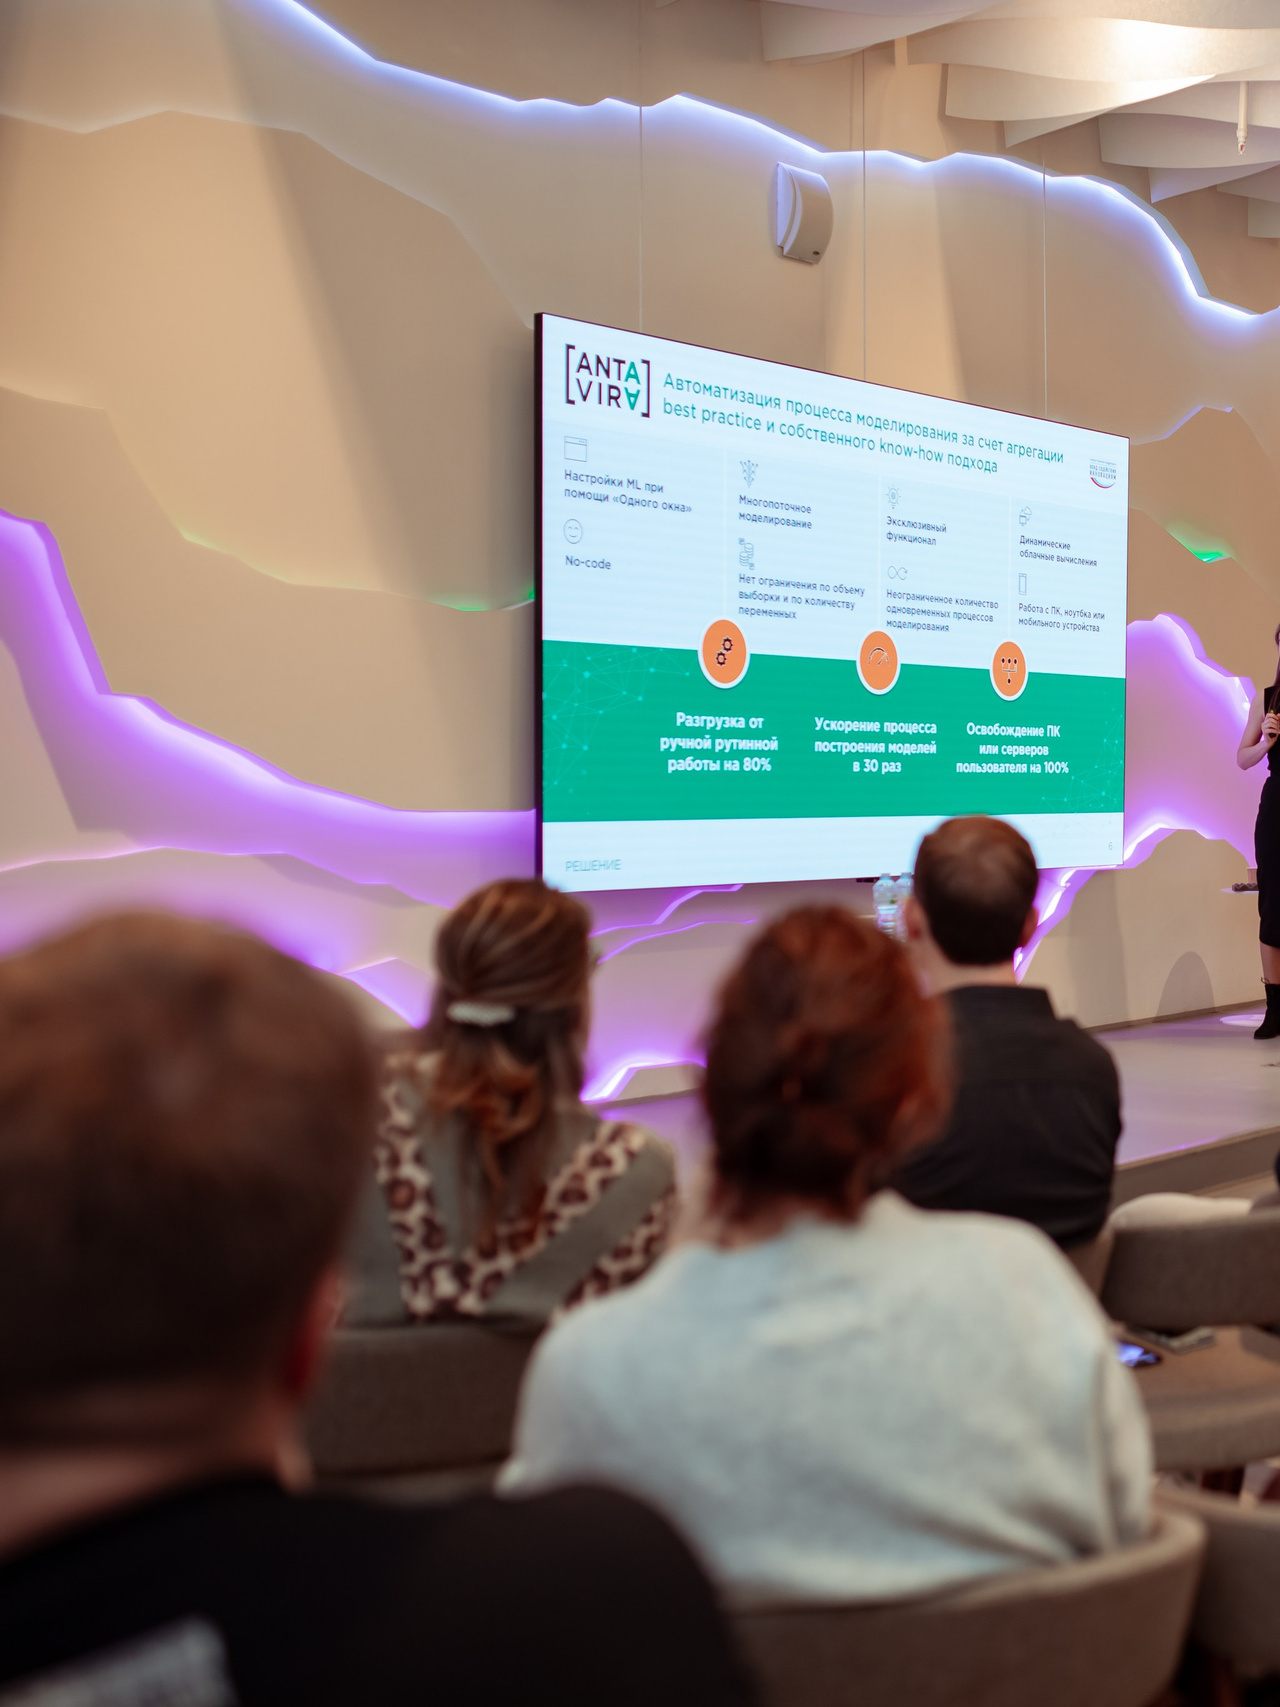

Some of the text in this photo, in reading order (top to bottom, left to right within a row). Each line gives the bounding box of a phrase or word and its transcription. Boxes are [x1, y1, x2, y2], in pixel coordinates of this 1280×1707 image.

[576, 352, 641, 385] ANTA
[663, 373, 1064, 465] Автоматизация процесса моделирования за счет агрегации
[663, 398, 998, 474] best practice и собственного know-how подхода
[564, 470, 664, 496] Настройки ML при
[564, 488, 692, 514] помощи «Одного окна»
[739, 495, 812, 514] Многопоточное
[739, 512, 812, 530] моделирование
[886, 516, 947, 533] Эксклюзивный
[886, 531, 937, 546] функционал
[1020, 535, 1071, 551] Динамические
[565, 555, 611, 570] No-code
[1020, 549, 1098, 567] облачные вычисления
[739, 573, 865, 597] Нет ограничения по объему
[739, 589, 855, 612] выборки и по количеству
[886, 589, 999, 610] Неограниченное количество
[739, 605, 797, 620] переменных
[886, 605, 994, 623] одновременных процессов
[1018, 603, 1105, 621] Работа с ПК, ноутбука или
[886, 619, 950, 633] моделирования
[1018, 616, 1100, 633] мобильного устройства
[676, 712, 764, 730] Разгрузка от
[814, 717, 937, 737] Ускорение процесса
[966, 722, 1061, 738] Освобождение ПК
[660, 735, 779, 752] ручной рутинной
[814, 741, 937, 755] построения моделей
[979, 743, 1049, 758] или серверов
[667, 756, 772, 773] работы на 80%
[852, 758, 902, 775] в 30 раз
[956, 761, 1069, 775] пользователя на 100%
[1108, 841, 1113, 851] 6
[565, 859, 621, 872] РЕШЕНИЕ
